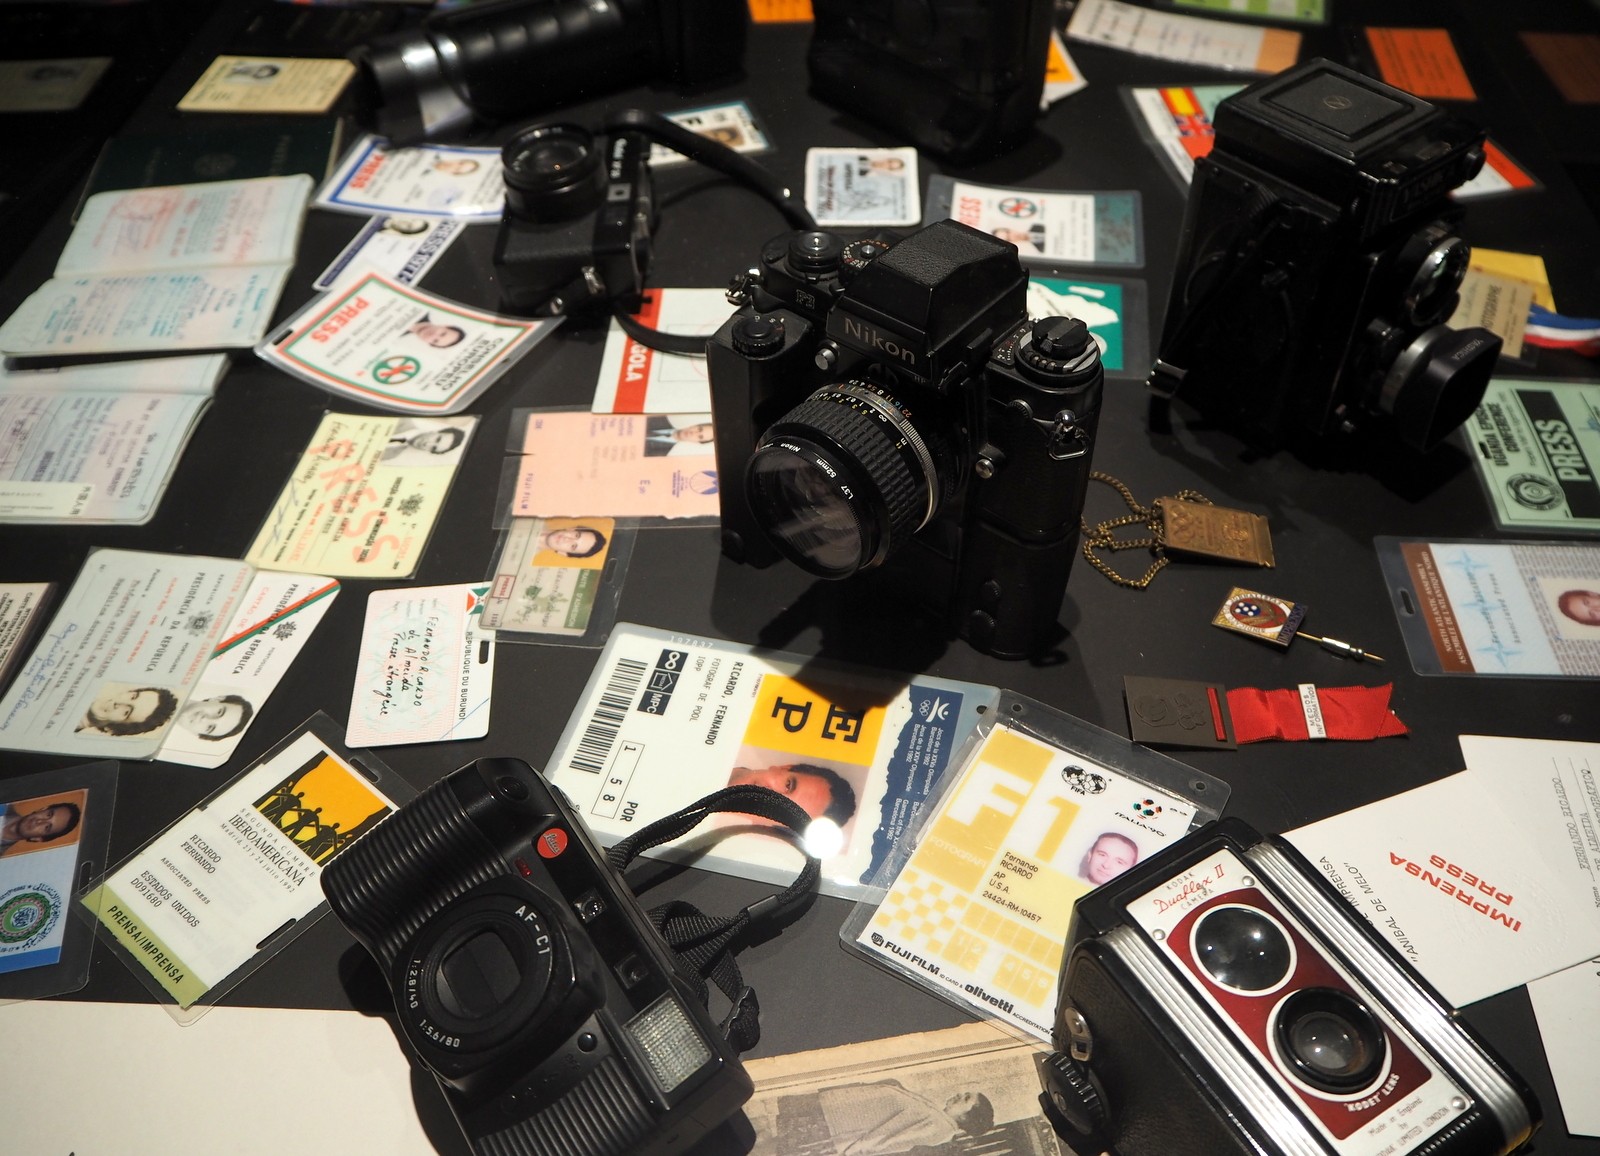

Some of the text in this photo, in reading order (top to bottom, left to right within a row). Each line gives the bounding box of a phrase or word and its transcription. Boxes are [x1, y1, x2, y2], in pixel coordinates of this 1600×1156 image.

[349, 154, 386, 189] PRESS
[305, 296, 373, 344] PRESS
[844, 318, 916, 365] Nikon
[429, 338, 493, 386] EUROPEU
[436, 337, 506, 391] CONSELHO
[1486, 402, 1520, 452] CONFERENCE
[1484, 432, 1509, 466] UGANDA
[1534, 418, 1591, 480] PRESS
[519, 472, 535, 509] FUJI FILM
[781, 443, 854, 500] Nikon 52mm L37
[307, 436, 401, 565] PRESS
[1415, 562, 1453, 651] NORTH ATLANTIC ASSEMBLY
[1420, 550, 1452, 624] DE L'ATLANTIQUE NORD
[143, 571, 207, 673] PRESIDÊNCIA DA REPÚBLICA
[1488, 572, 1521, 643] Associated Press
[77, 618, 102, 650] durante
[53, 661, 75, 689] visita
[93, 646, 118, 679] RICARDO
[230, 637, 262, 676] REPÚBLICA
[692, 655, 706, 671] IOPP
[458, 676, 468, 720] DU BURUNDI
[645, 692, 662, 713] MPC
[688, 657, 721, 723] FOTOGRAF DE POOL
[703, 661, 744, 746] RICARDO, FERNANDO
[765, 695, 813, 735] P
[818, 704, 868, 746] E
[1303, 695, 1315, 726] MEDIOS
[623, 744, 637, 752] 1
[903, 722, 921, 763] Barcelona 1992
[917, 724, 927, 737] Jeux
[921, 726, 939, 765] Barcelona 1992
[934, 727, 944, 740] Jocs
[902, 763, 920, 792] Olympiade
[1068, 785, 1087, 796] FIFA
[602, 794, 616, 802] 8
[619, 800, 638, 822] POR
[896, 798, 909, 819] Games
[884, 797, 902, 840] Barcelona 1992
[1552, 777, 1590, 870] FERNANDO RICARDO
[1579, 812, 1600, 853] ALMEIDA
[178, 839, 217, 876] FERNANDO
[188, 833, 223, 865] RICARDO
[217, 821, 245, 847] Madrid,
[260, 862, 282, 881] julio
[276, 877, 297, 894] 1992
[226, 812, 308, 888] IBEROAMERICANA
[238, 806, 318, 879] SEGUNDA CUMBRE
[543, 833, 561, 855] Leica
[1002, 850, 1042, 874] Fernando
[159, 855, 212, 906] ASSOCIATED PRESS
[986, 878, 1013, 895] U.S.A.
[992, 869, 1007, 881] AP
[997, 858, 1035, 881] RICARDO
[1150, 863, 1227, 915] Duaflex II
[1165, 870, 1195, 891] KODAK
[1429, 854, 1514, 906] PRESS
[129, 876, 164, 909] D091680
[139, 869, 202, 929] ESTADOS UNIDOS
[979, 889, 1043, 924] 24424-RM-10457
[1179, 886, 1215, 911] CAMERA
[1370, 897, 1387, 913] DE
[1389, 851, 1521, 932] IMPRENSA
[104, 904, 187, 985] PRENSA/IMPRENSA
[515, 905, 551, 955] AF-C1
[409, 959, 422, 1009] 1:2.8/40
[944, 976, 960, 987] CARD
[962, 981, 1015, 1015] olivetti
[1011, 1010, 1052, 1035] ACCREDITATION
[419, 1019, 461, 1048] 1:5.6/80
[1382, 1073, 1400, 1096] LENS
